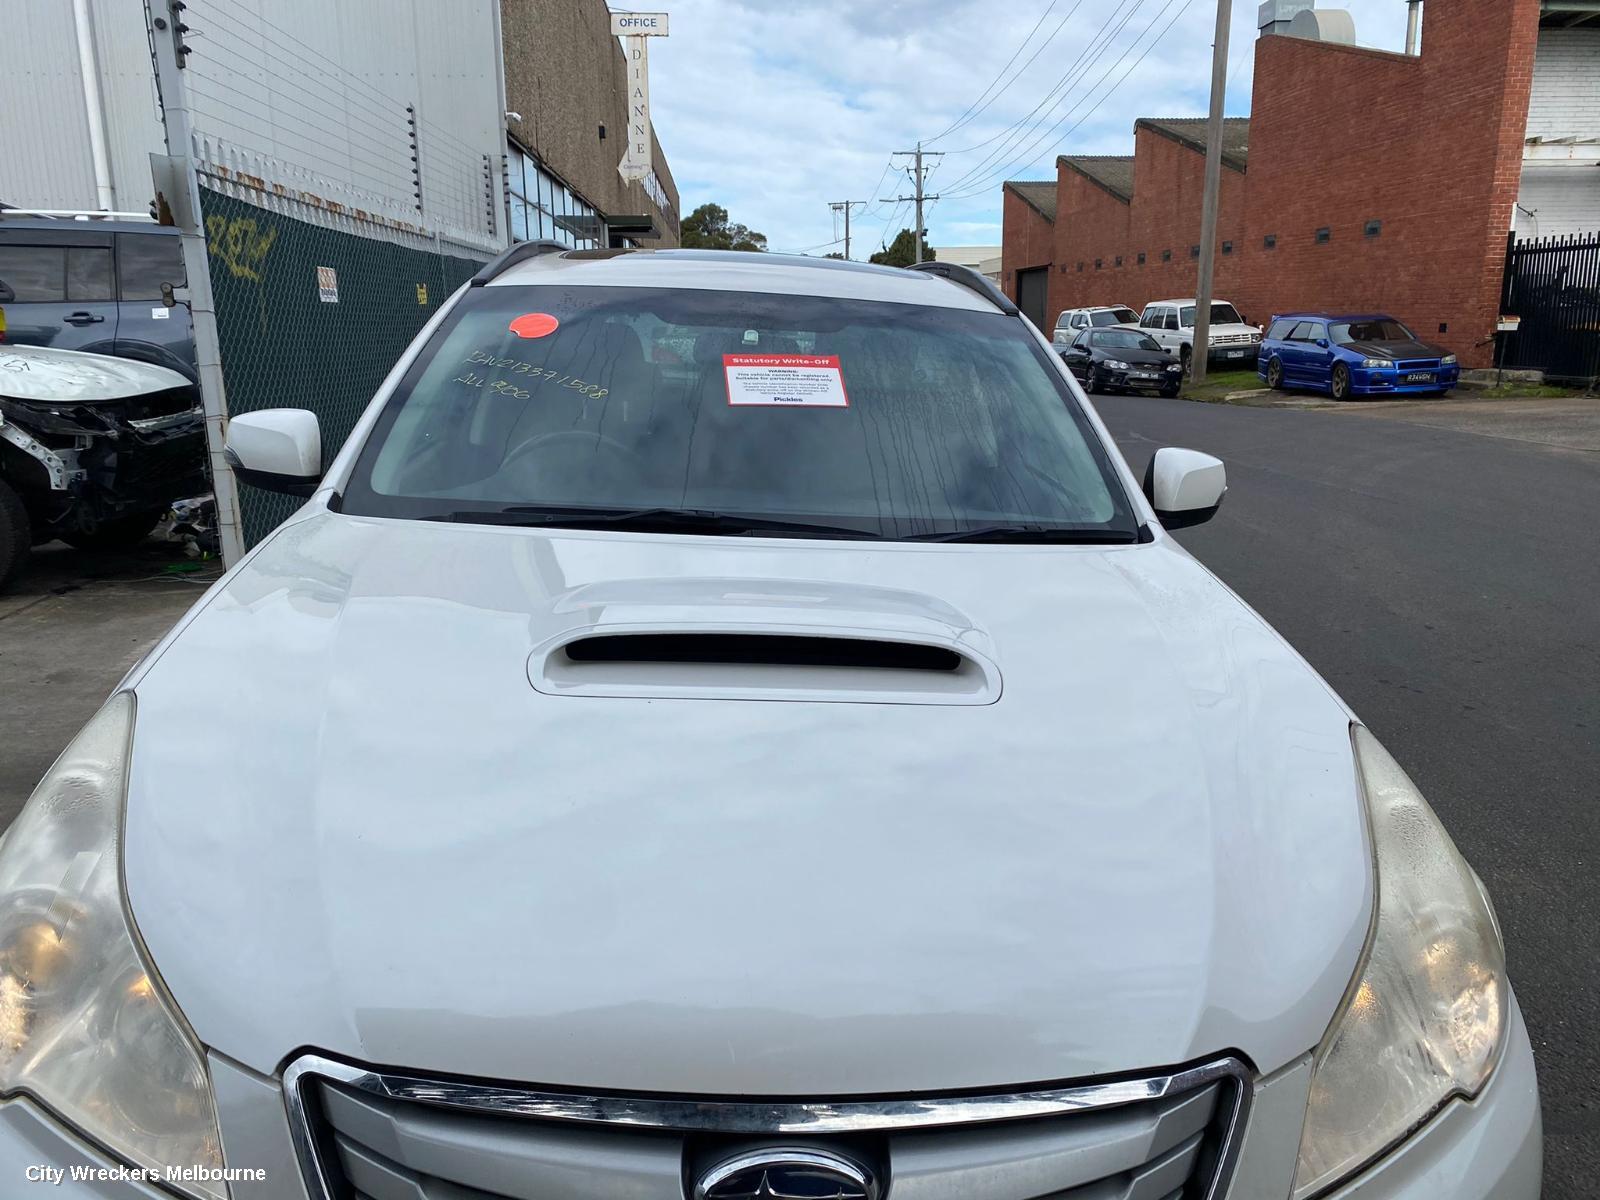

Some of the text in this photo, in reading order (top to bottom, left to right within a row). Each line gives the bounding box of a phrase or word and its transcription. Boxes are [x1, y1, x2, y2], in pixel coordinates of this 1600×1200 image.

[619, 18, 657, 28] OFFICE
[632, 49, 645, 154] DIANNE
[732, 358, 830, 366] Statutory Write-Off
